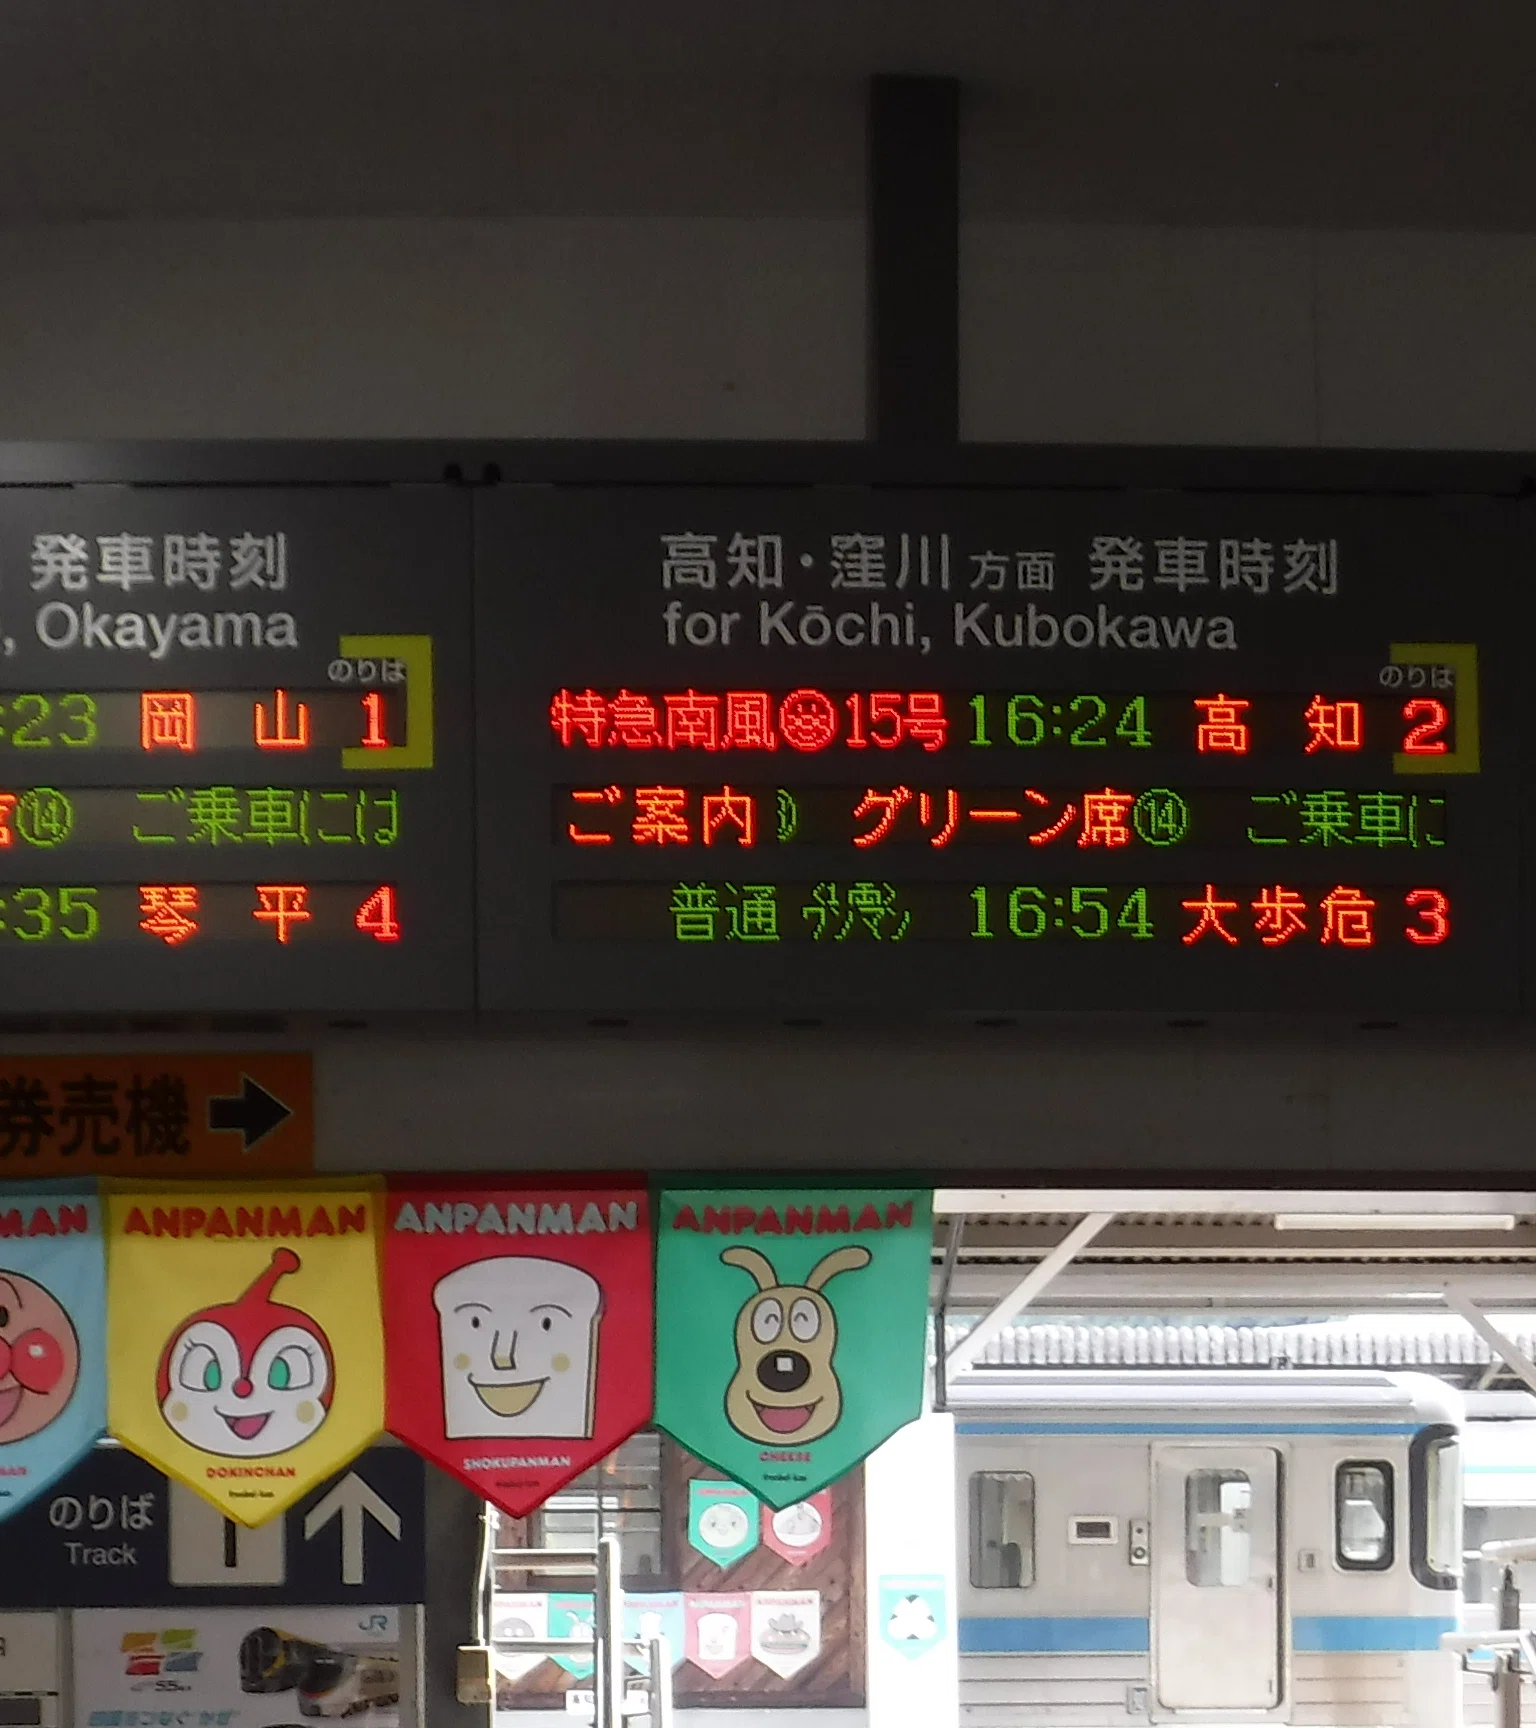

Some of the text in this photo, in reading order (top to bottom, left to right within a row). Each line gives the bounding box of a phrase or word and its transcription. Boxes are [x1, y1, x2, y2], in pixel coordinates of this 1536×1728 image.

[28, 532, 290, 593] 発車時刻
[660, 532, 1341, 597] 高知・窪川 方面 発車時刻
[35, 602, 299, 659] Okayama
[664, 602, 739, 648] for
[953, 602, 1239, 653] Kubokawa
[360, 690, 390, 749] 1
[968, 693, 1155, 750] 16:24
[1401, 698, 1451, 756] 2
[131, 784, 400, 849] ご乗車には
[567, 785, 757, 849] ご案内
[353, 884, 403, 943] 4
[668, 881, 783, 943] 普通
[969, 884, 1156, 942] 16:54
[1180, 882, 1377, 947] 大歩危
[1404, 888, 1451, 946] 3
[123, 1204, 365, 1239] ANPANMAN
[394, 1201, 639, 1236] ANPANMAN
[672, 1201, 914, 1236] ANPANMAN
[206, 1465, 297, 1480] DOKINCHAN
[49, 1493, 156, 1533] のりば
[64, 1541, 139, 1568] Track
